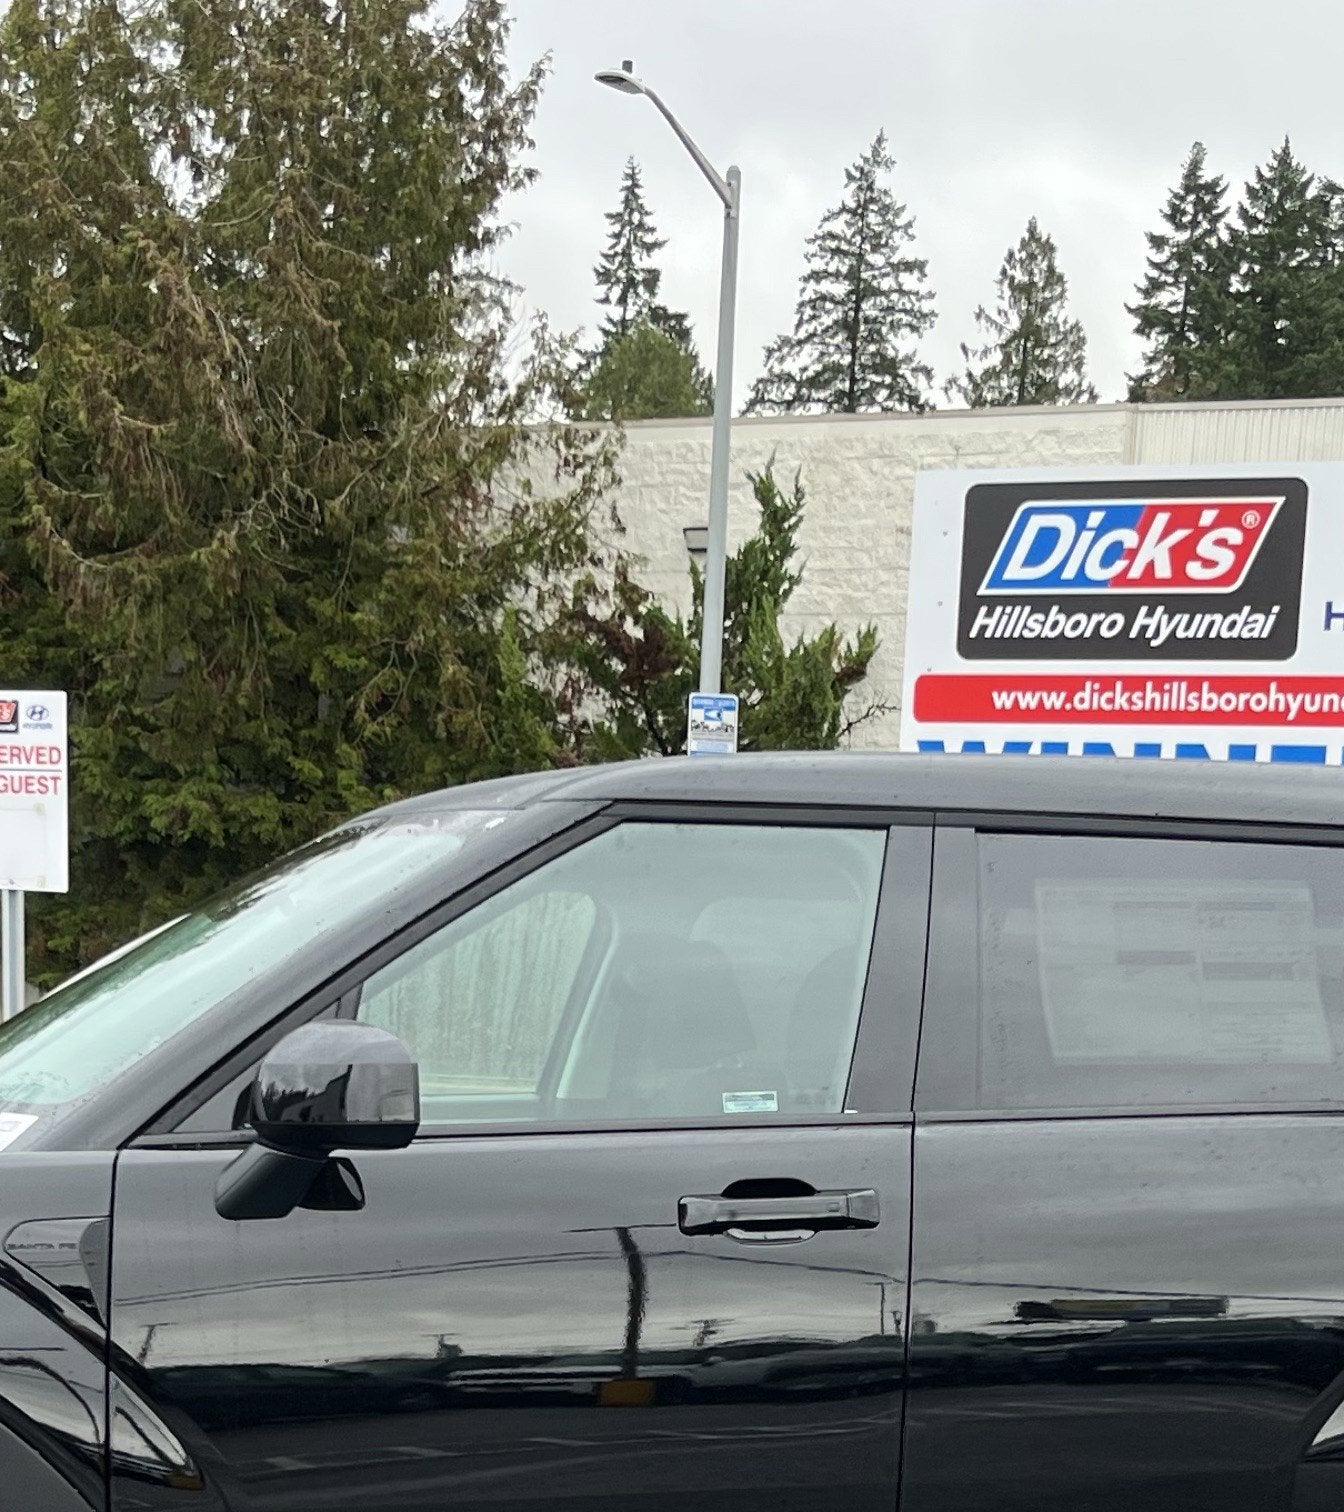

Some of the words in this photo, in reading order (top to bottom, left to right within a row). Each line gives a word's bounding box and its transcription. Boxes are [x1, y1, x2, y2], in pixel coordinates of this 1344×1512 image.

[1002, 509, 1244, 581] Dick's
[969, 606, 1125, 639] Hillsboro
[1129, 606, 1281, 648] Hyundai
